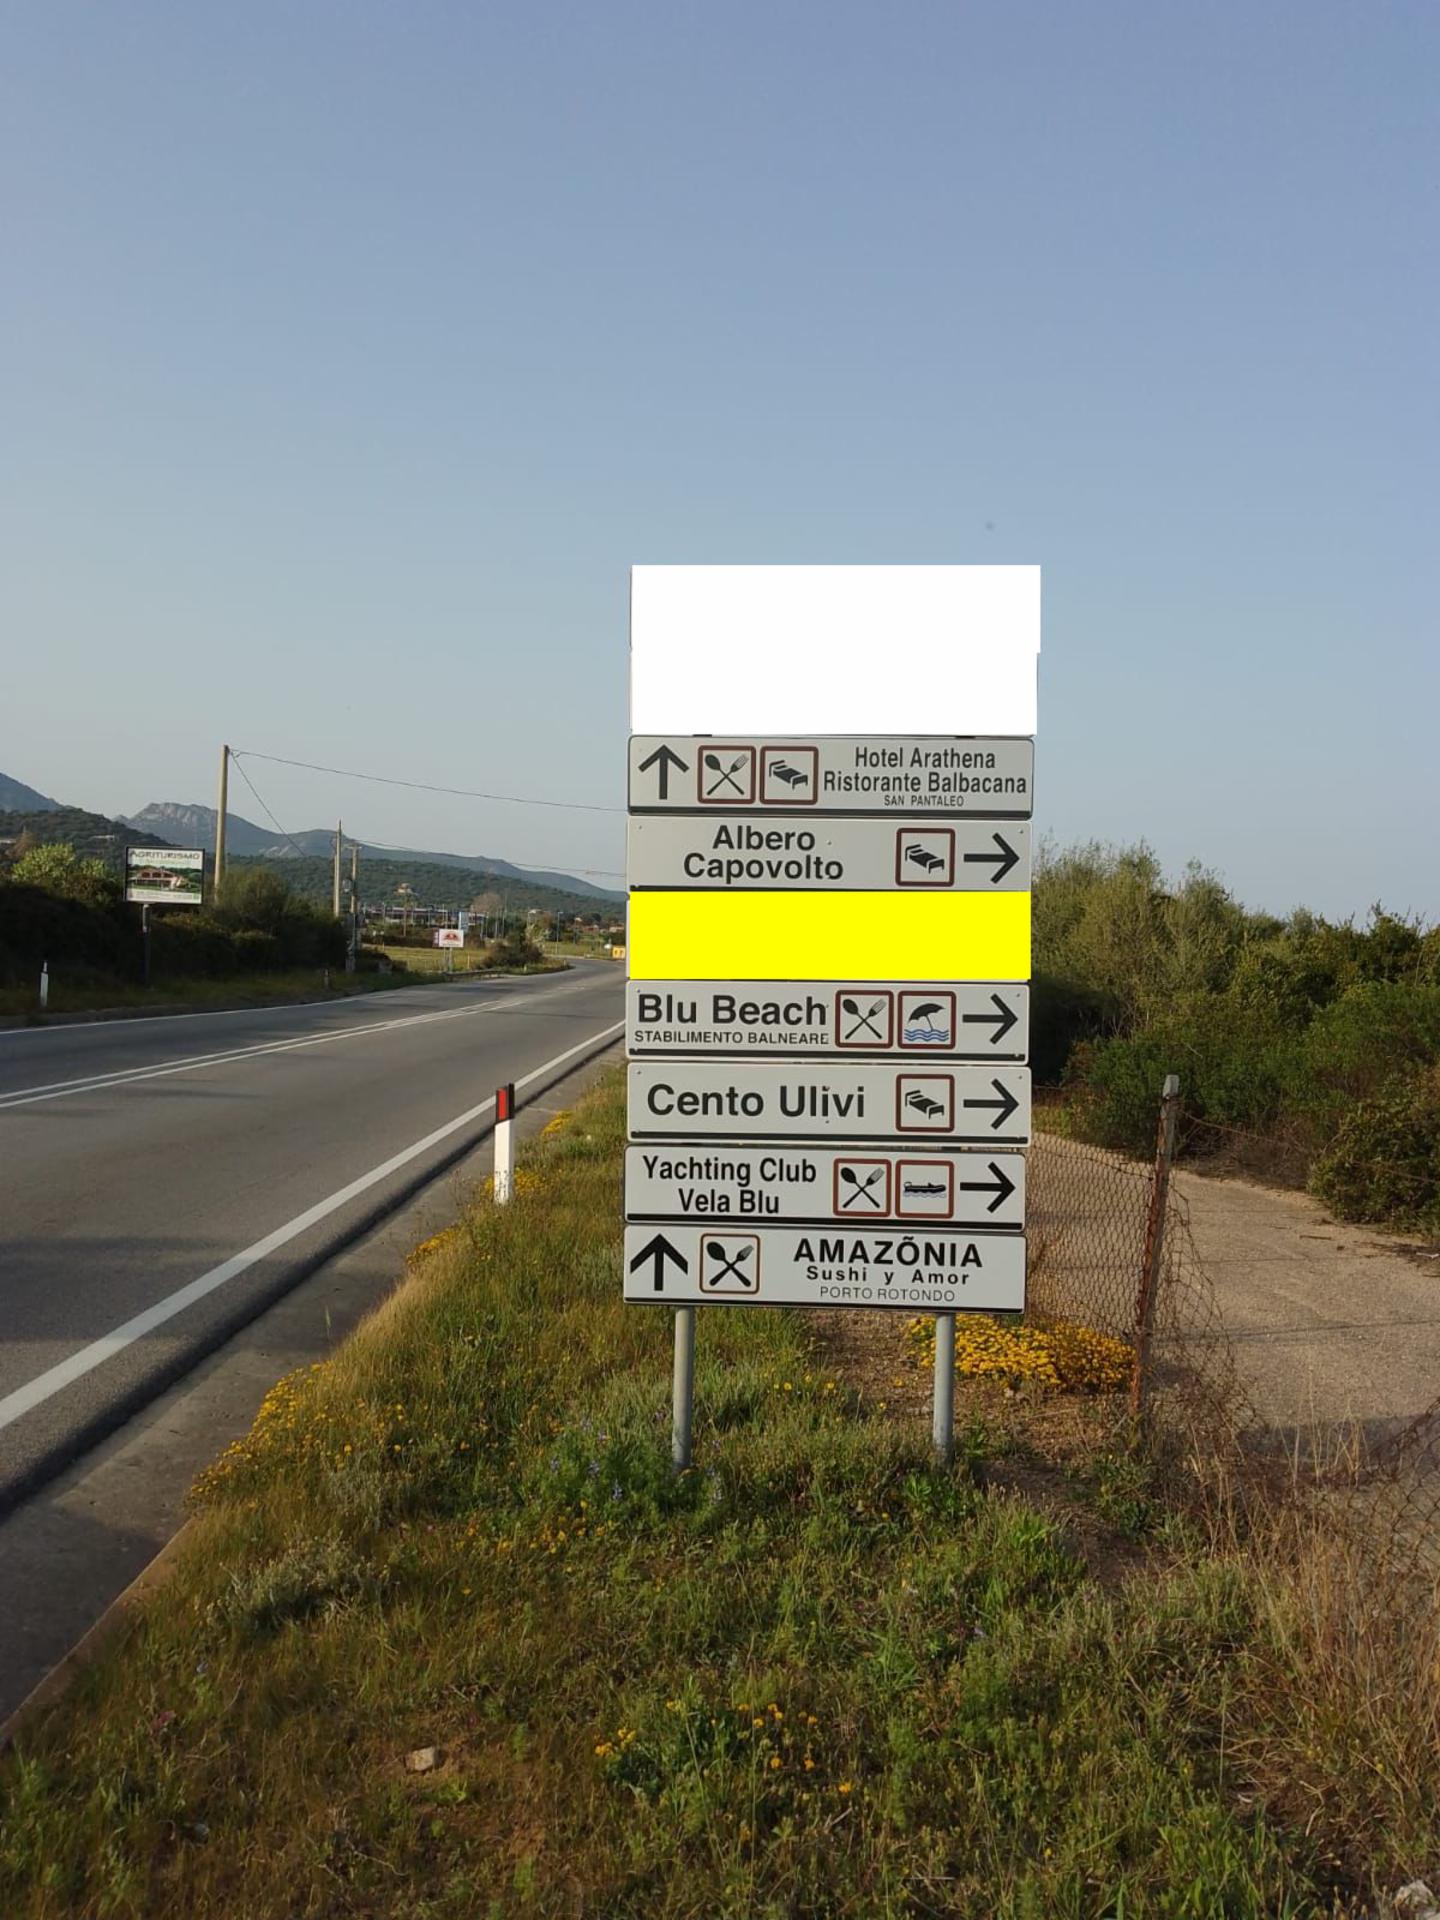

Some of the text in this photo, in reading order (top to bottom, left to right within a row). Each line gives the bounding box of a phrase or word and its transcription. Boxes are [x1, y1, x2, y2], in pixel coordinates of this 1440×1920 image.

[855, 747, 996, 769] Hotel Arathena
[824, 771, 1027, 794] Ristorante Balbacana
[884, 795, 964, 807] SAN PANTALEO
[712, 825, 815, 851] Albero
[683, 853, 844, 884] Capovolto
[637, 994, 826, 1026] Blu Beach
[634, 1030, 829, 1045] STABILIMENTO BALNEARE
[647, 1084, 865, 1118] Cento Ulivi
[643, 1155, 816, 1187] Yachting Club
[678, 1188, 779, 1214] Vela Blu
[793, 1236, 983, 1268] AMAZÕNIA
[806, 1265, 970, 1285] Sushi y Amor
[820, 1286, 955, 1302] PORTO ROTONDO
